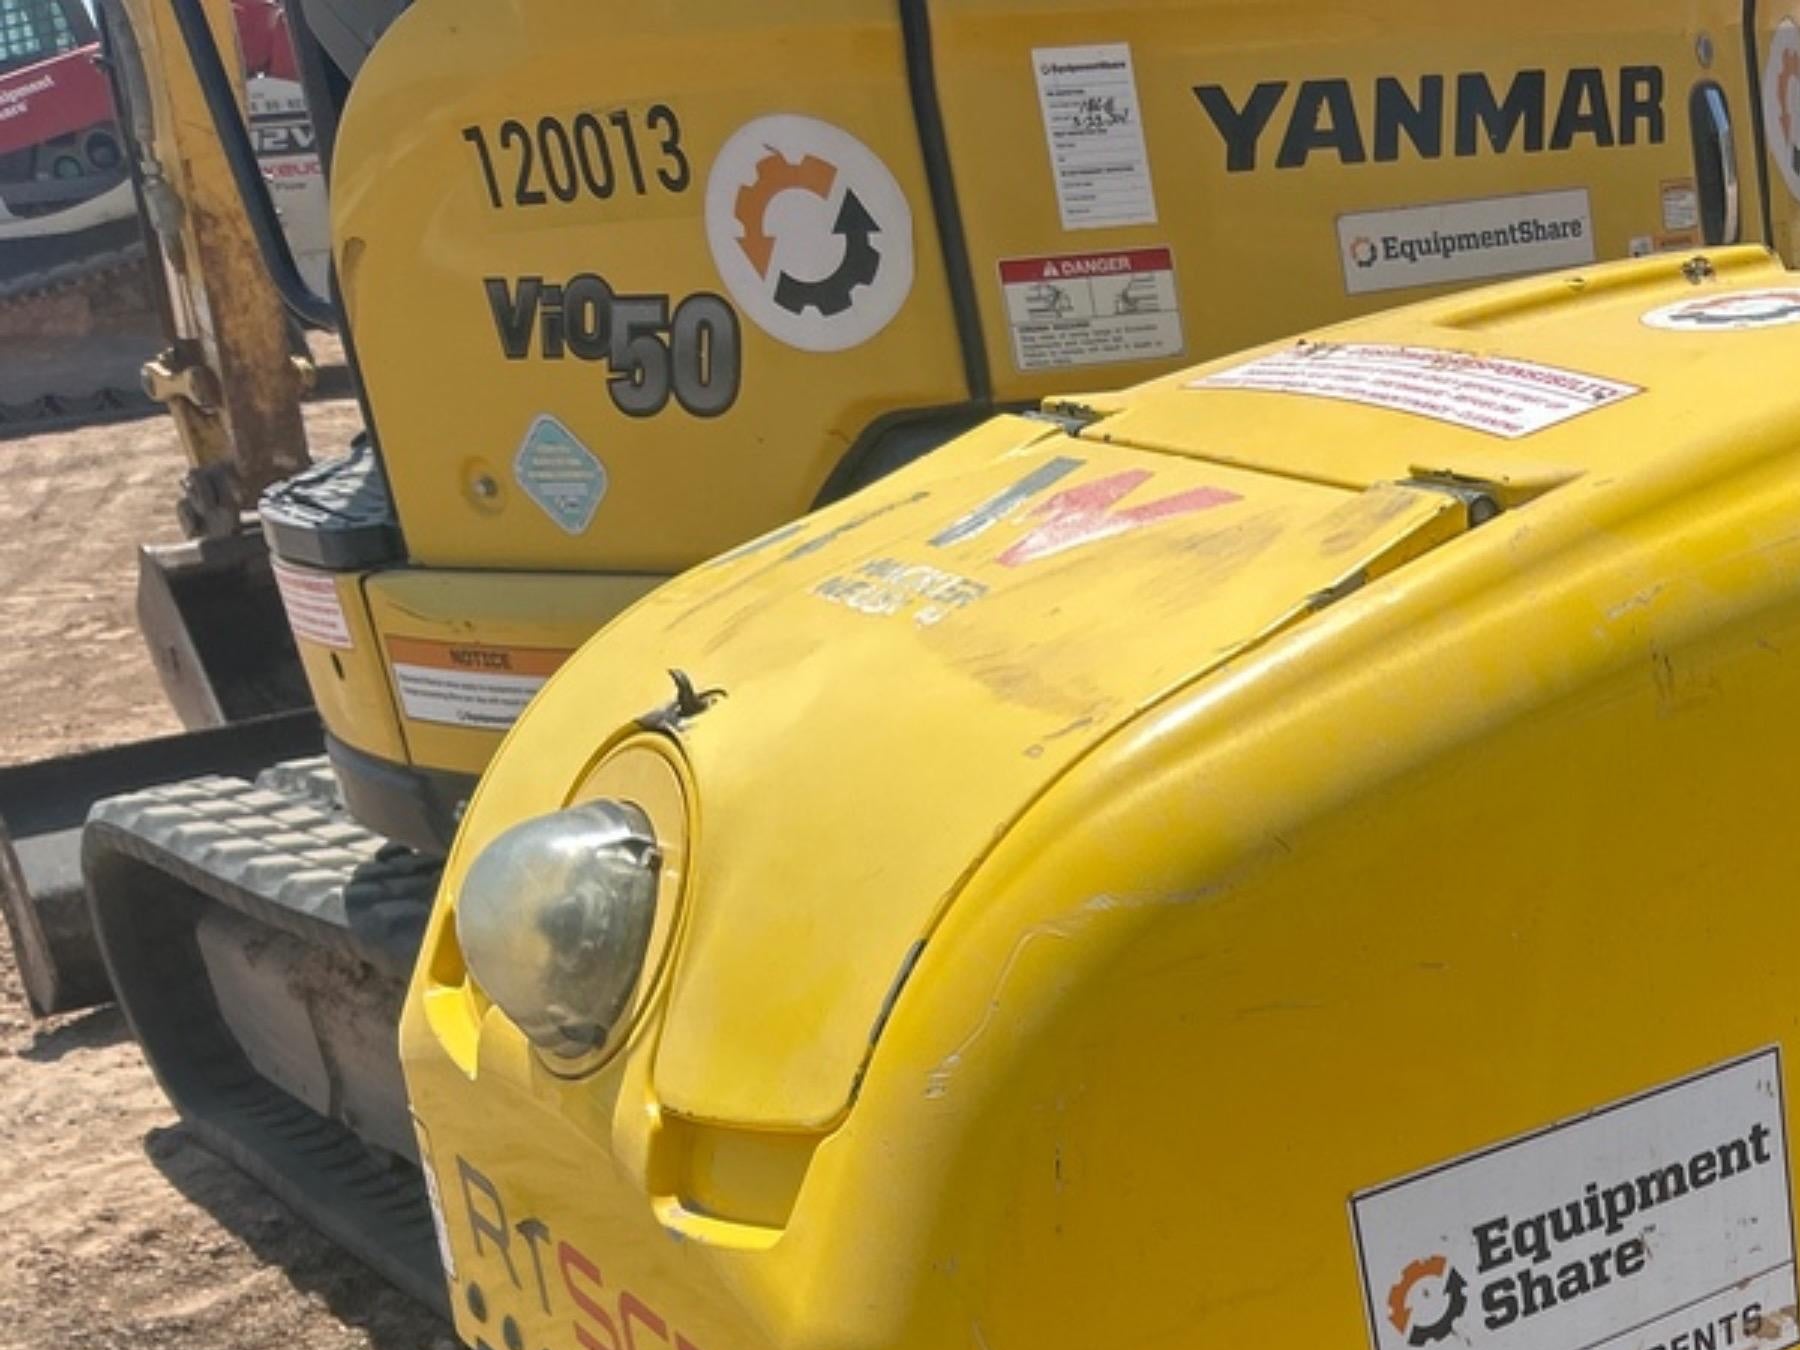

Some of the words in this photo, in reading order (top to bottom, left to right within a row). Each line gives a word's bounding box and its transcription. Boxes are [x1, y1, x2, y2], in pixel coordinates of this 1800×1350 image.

[462, 104, 690, 208] 120013
[1193, 65, 1665, 172] YANMAR
[1060, 256, 1132, 276] DANGER
[1381, 217, 1584, 261] EquipmentShare
[1472, 1121, 1771, 1273] Equipment
[1482, 1238, 1647, 1331] Share
